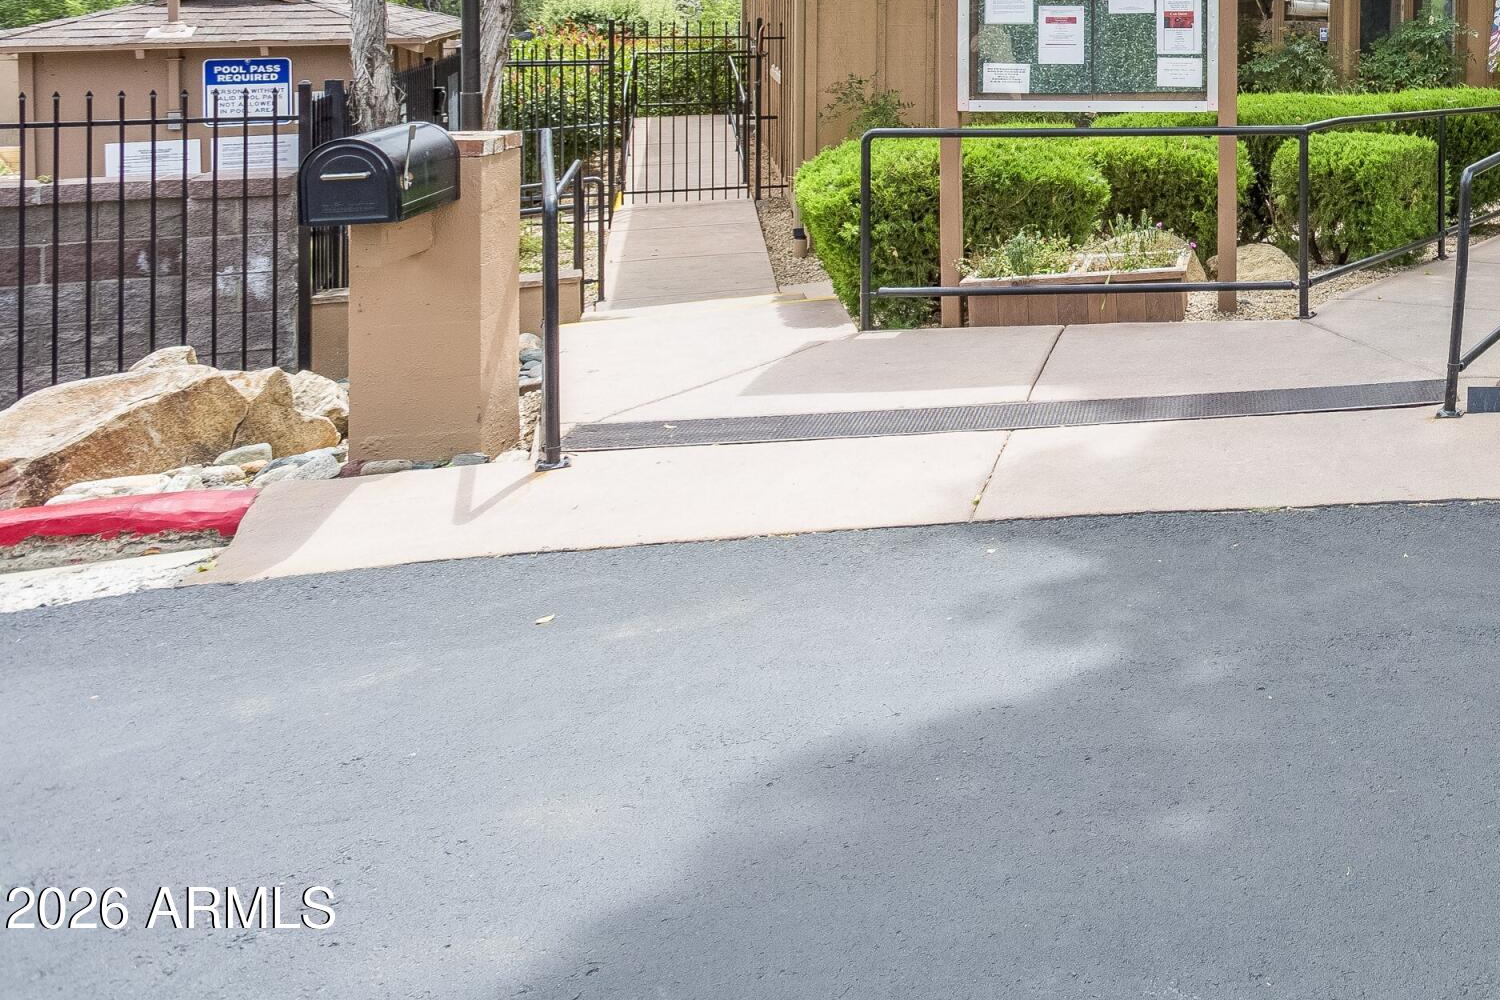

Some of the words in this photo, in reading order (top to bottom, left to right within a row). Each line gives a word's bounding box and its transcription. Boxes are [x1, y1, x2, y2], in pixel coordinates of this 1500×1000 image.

[213, 66, 246, 74] POOL
[250, 65, 281, 73] PASS
[217, 73, 279, 82] REQUIRED
